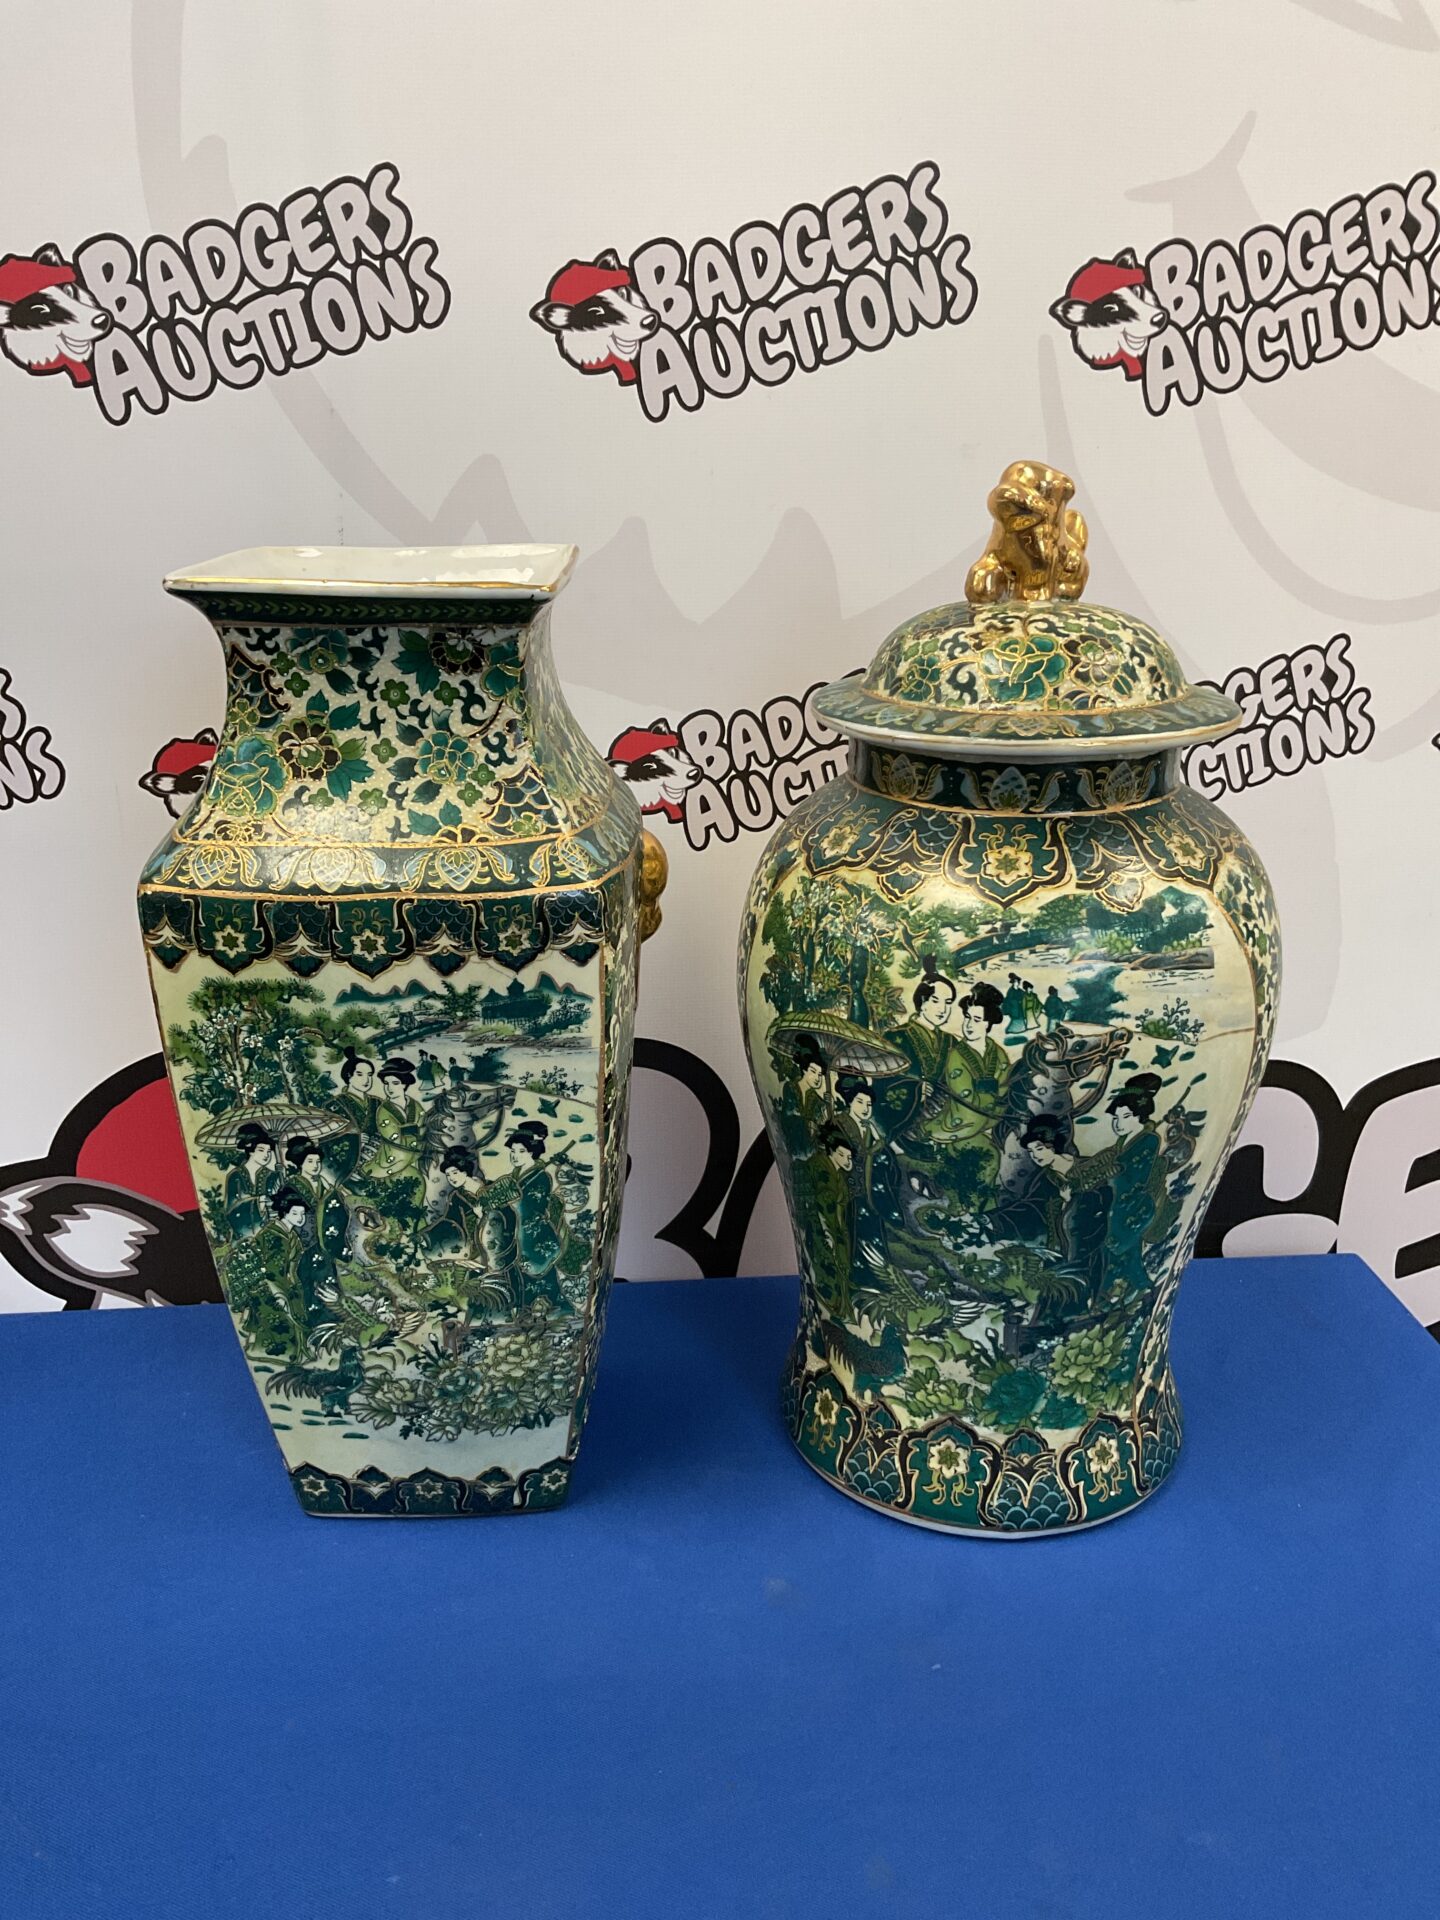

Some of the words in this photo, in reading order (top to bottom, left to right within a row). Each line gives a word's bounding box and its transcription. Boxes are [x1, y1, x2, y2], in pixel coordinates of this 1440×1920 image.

[72, 162, 413, 335] BADGERS
[93, 237, 451, 427] AUCTIONS
[629, 160, 948, 333] BADGERS
[636, 234, 978, 423] AUCTIONS
[1142, 246, 1440, 417] AUCTION
[1145, 170, 1440, 329] BADGERS
[1195, 633, 1355, 731] GERS
